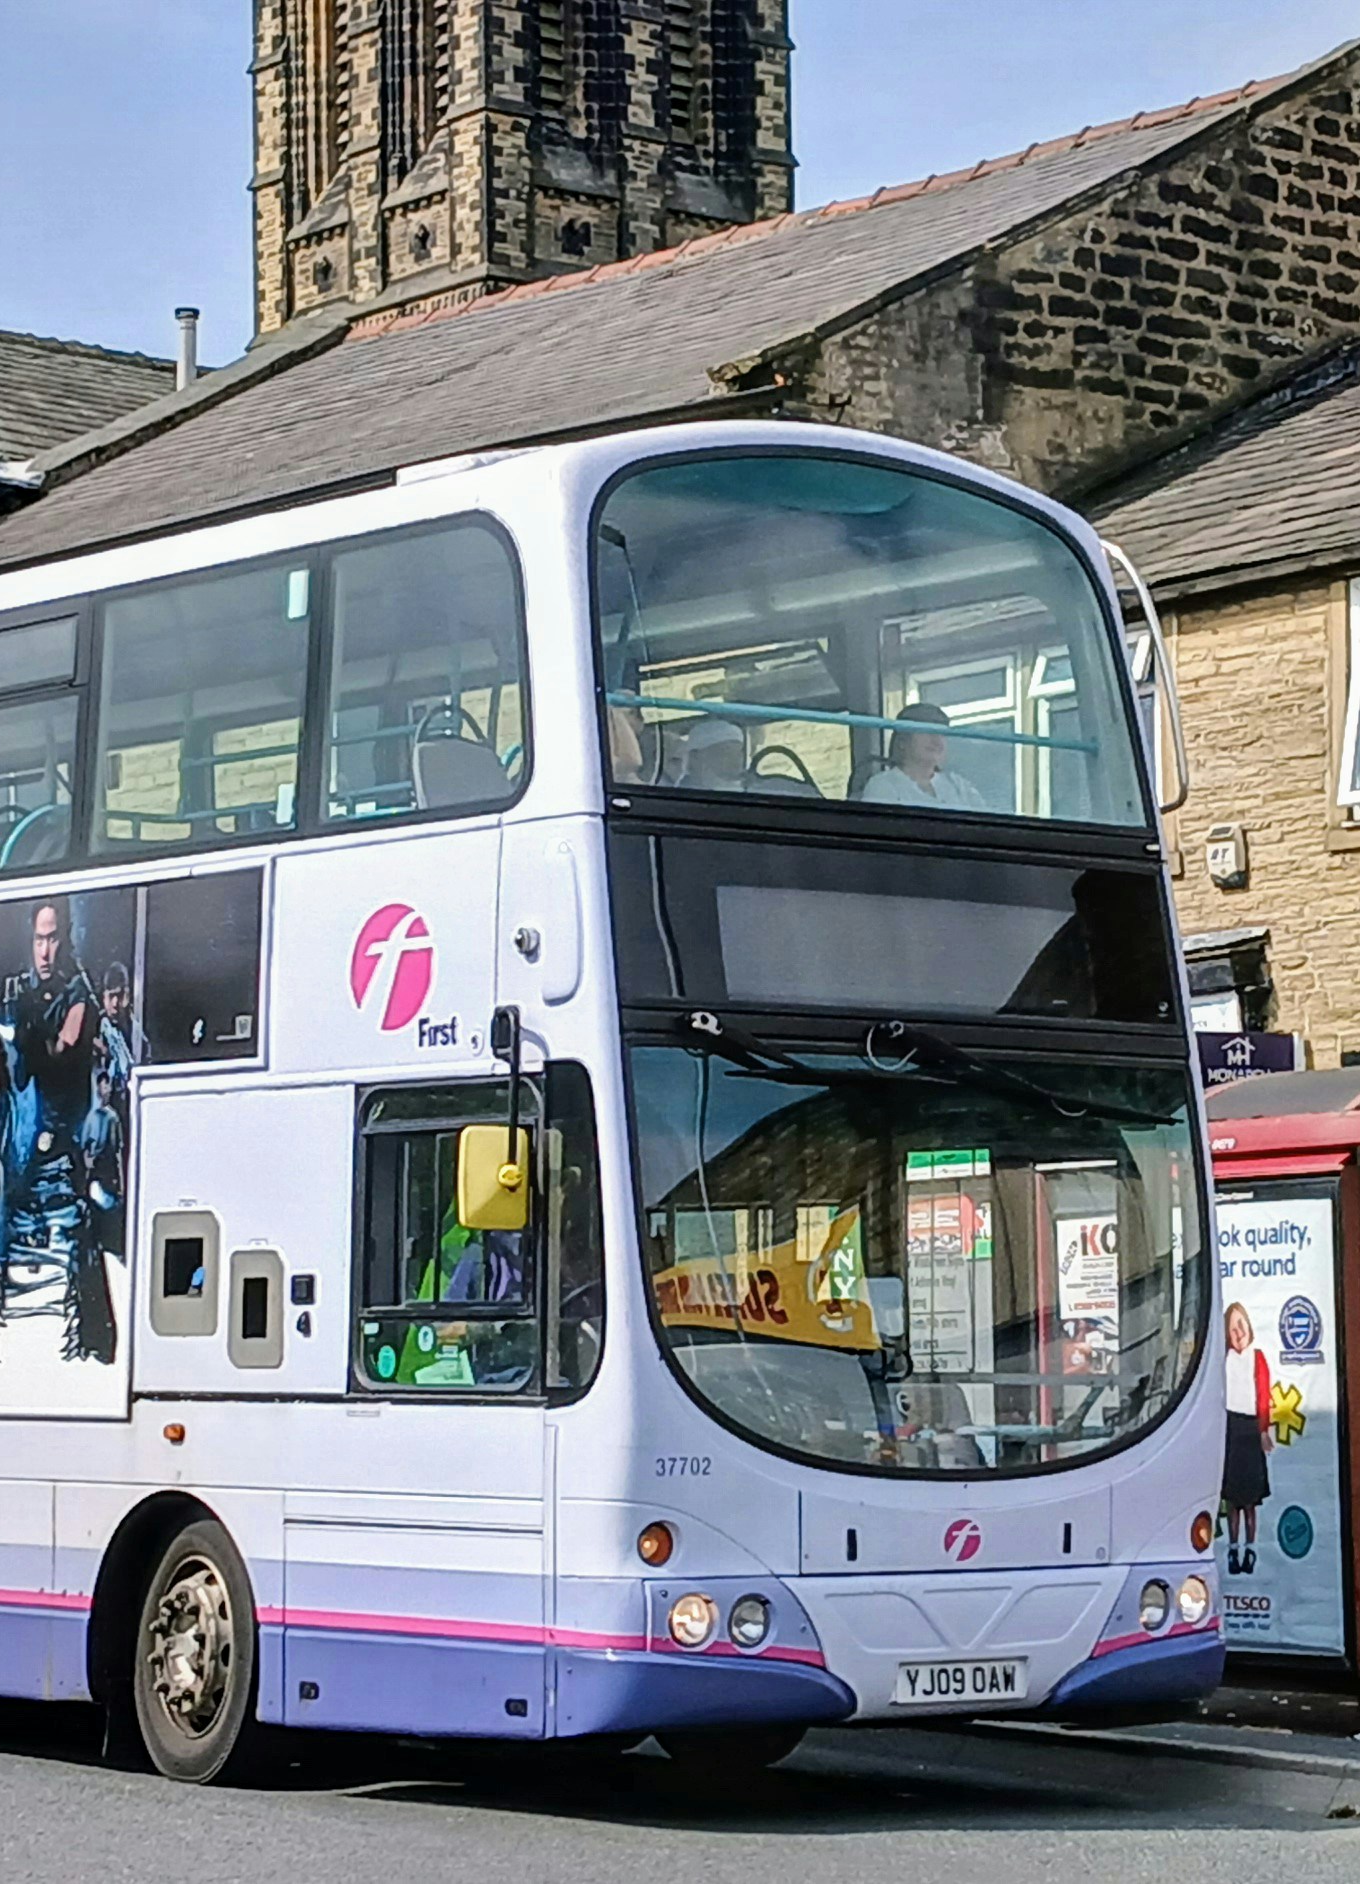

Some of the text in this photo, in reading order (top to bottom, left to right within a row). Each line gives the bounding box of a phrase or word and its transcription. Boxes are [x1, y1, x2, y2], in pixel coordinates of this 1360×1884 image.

[418, 1016, 457, 1048] First
[1244, 1219, 1312, 1253] quality,
[1241, 1252, 1296, 1278] round
[655, 1456, 712, 1477] 37702
[1223, 1595, 1271, 1611] TESCO
[906, 1664, 1016, 1697] YJ09 OAW
